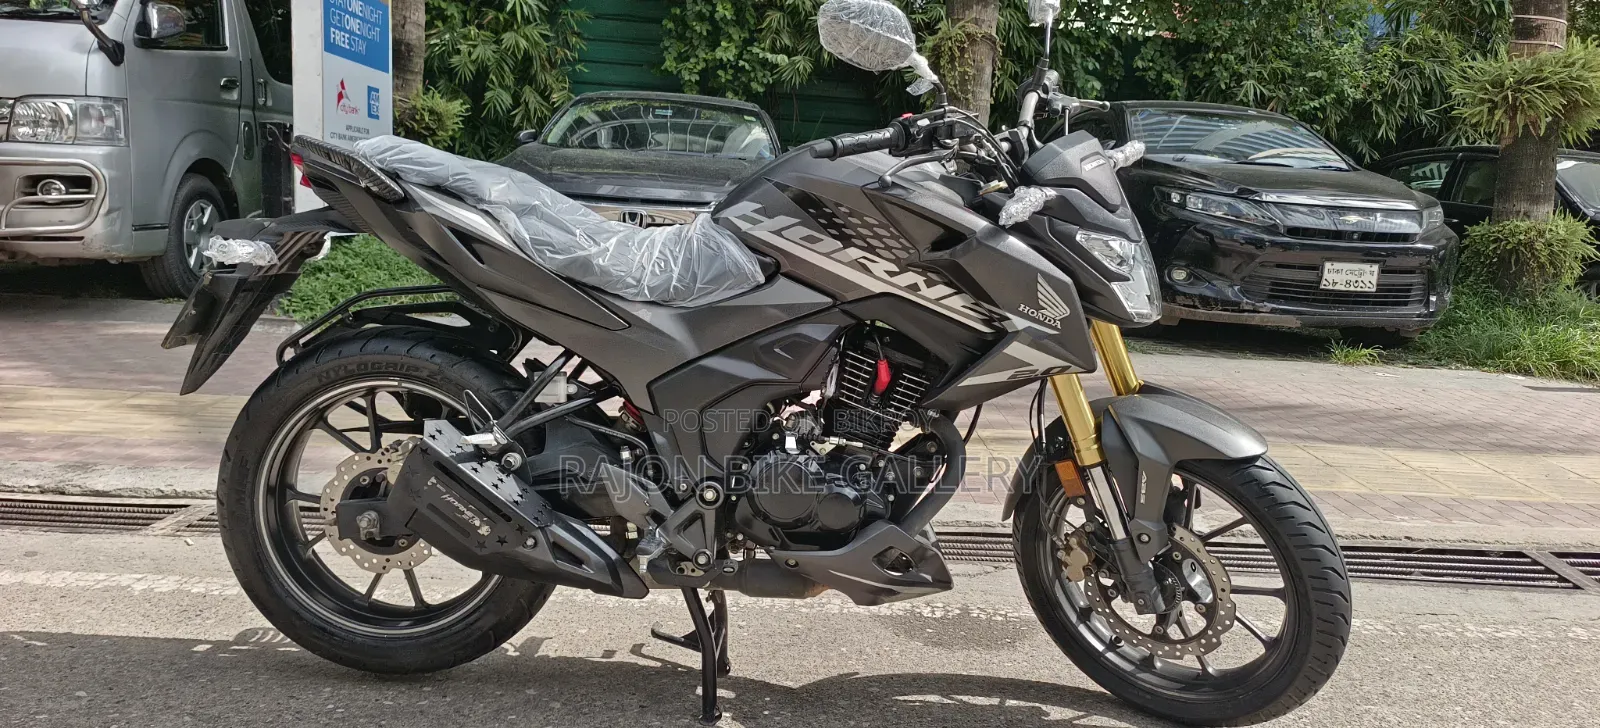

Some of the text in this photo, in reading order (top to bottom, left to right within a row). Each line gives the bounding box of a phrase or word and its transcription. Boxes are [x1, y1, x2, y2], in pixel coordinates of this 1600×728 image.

[331, 27, 367, 55] FREE STAY
[1322, 278, 1375, 290] ১৮-৪৩১১
[1018, 303, 1061, 329] HONDA
